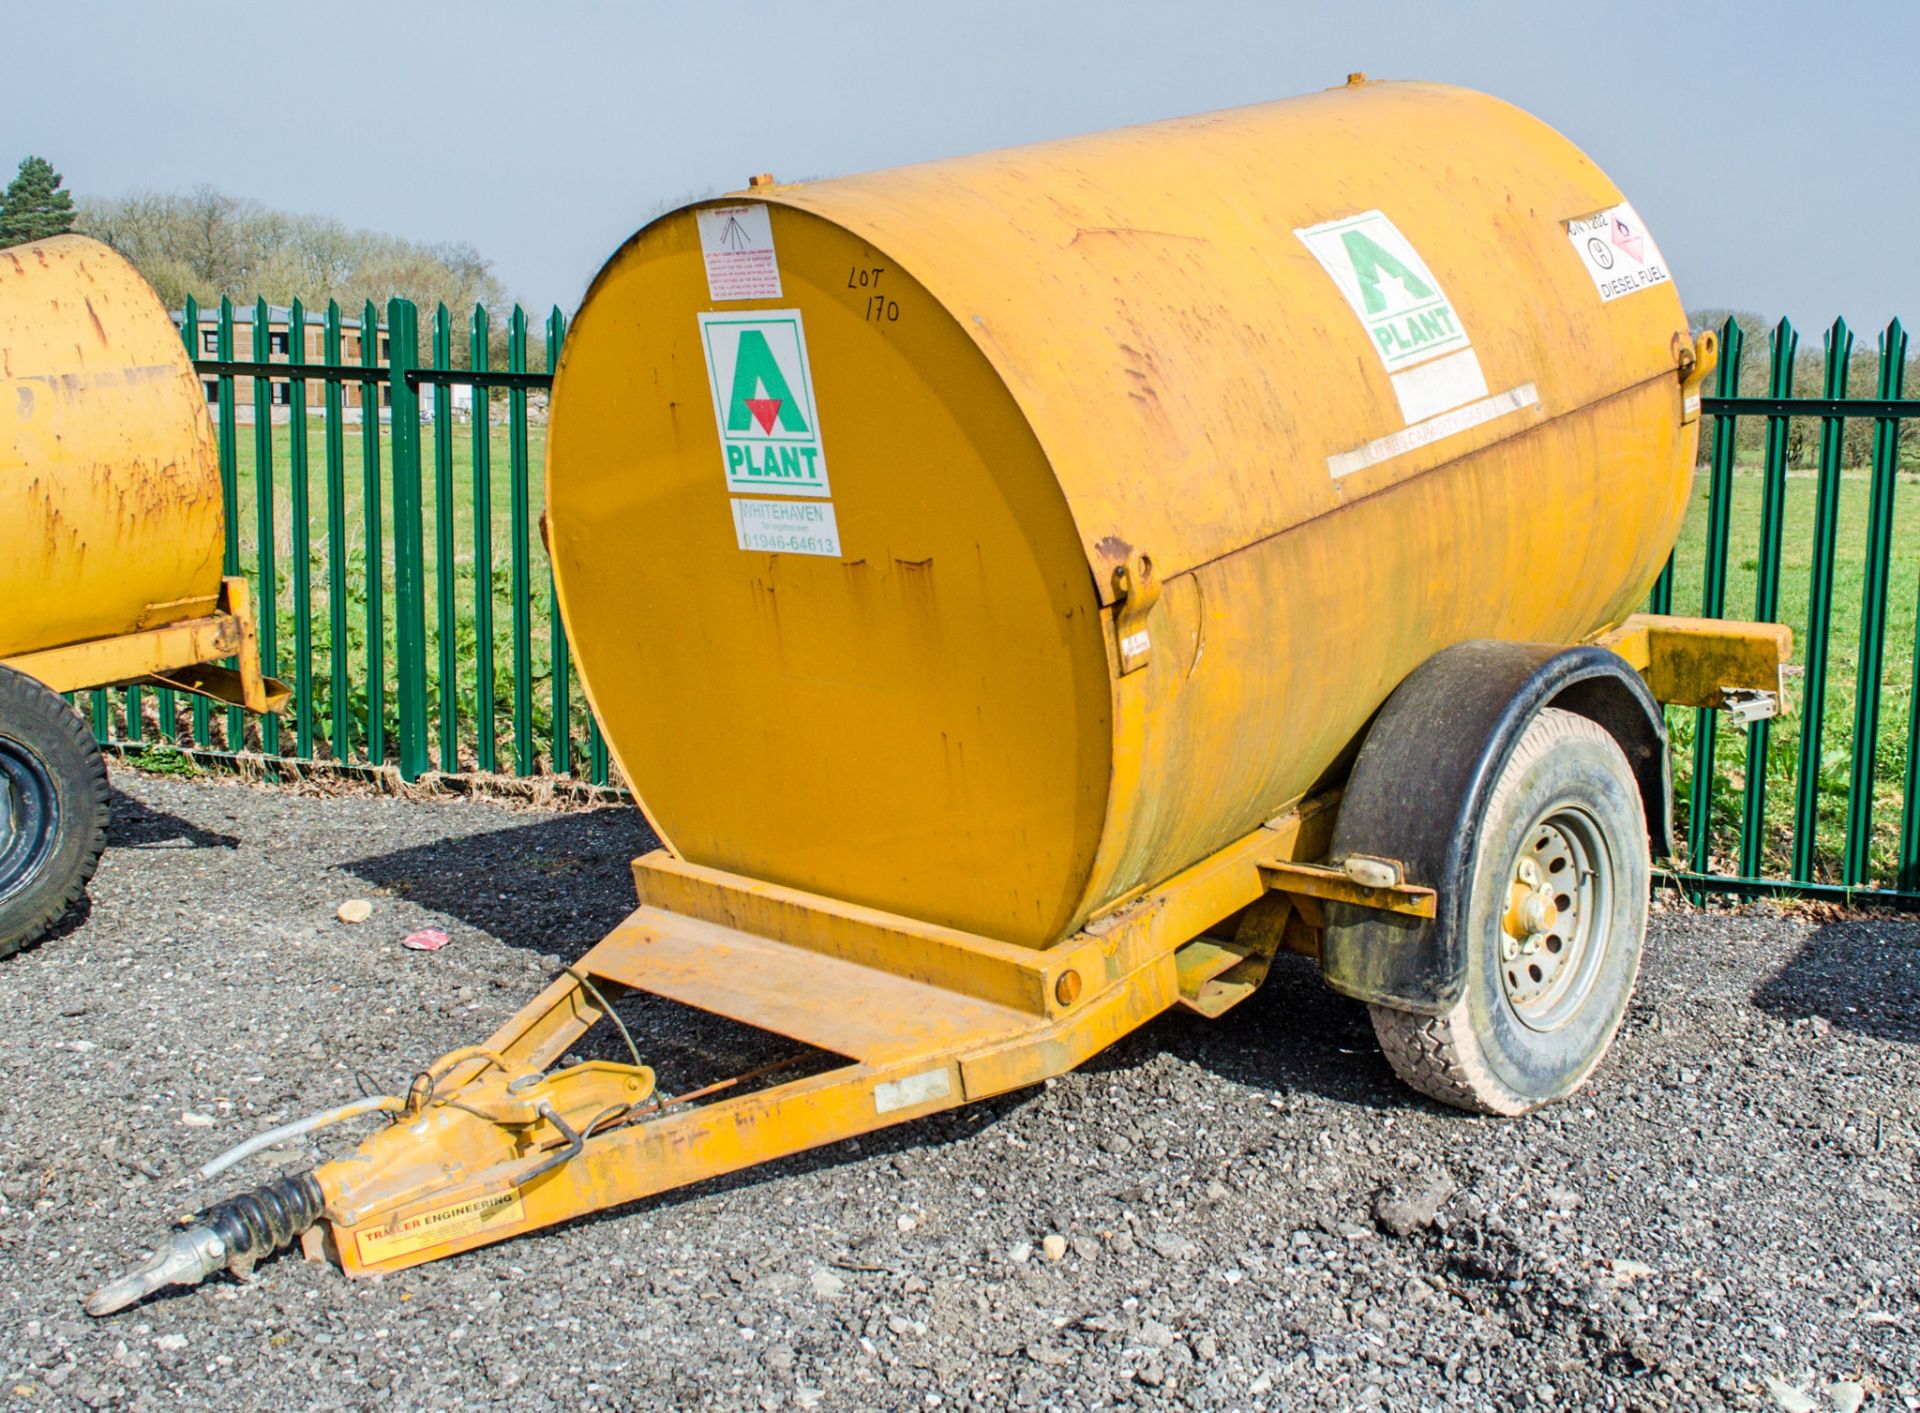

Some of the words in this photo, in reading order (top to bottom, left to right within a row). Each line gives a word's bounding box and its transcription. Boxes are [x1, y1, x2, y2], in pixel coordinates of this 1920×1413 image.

[1584, 214, 1609, 231] 1202
[848, 266, 885, 289] LOT
[1601, 273, 1640, 298] DIESEL
[1638, 265, 1666, 286] FUEL
[866, 295, 899, 321] 170
[1372, 305, 1456, 356] PLANT
[727, 330, 810, 433] A
[726, 444, 818, 479] PLANT
[741, 502, 824, 521] WHITEHAVEN
[424, 1193, 513, 1225] ENGINEERING
